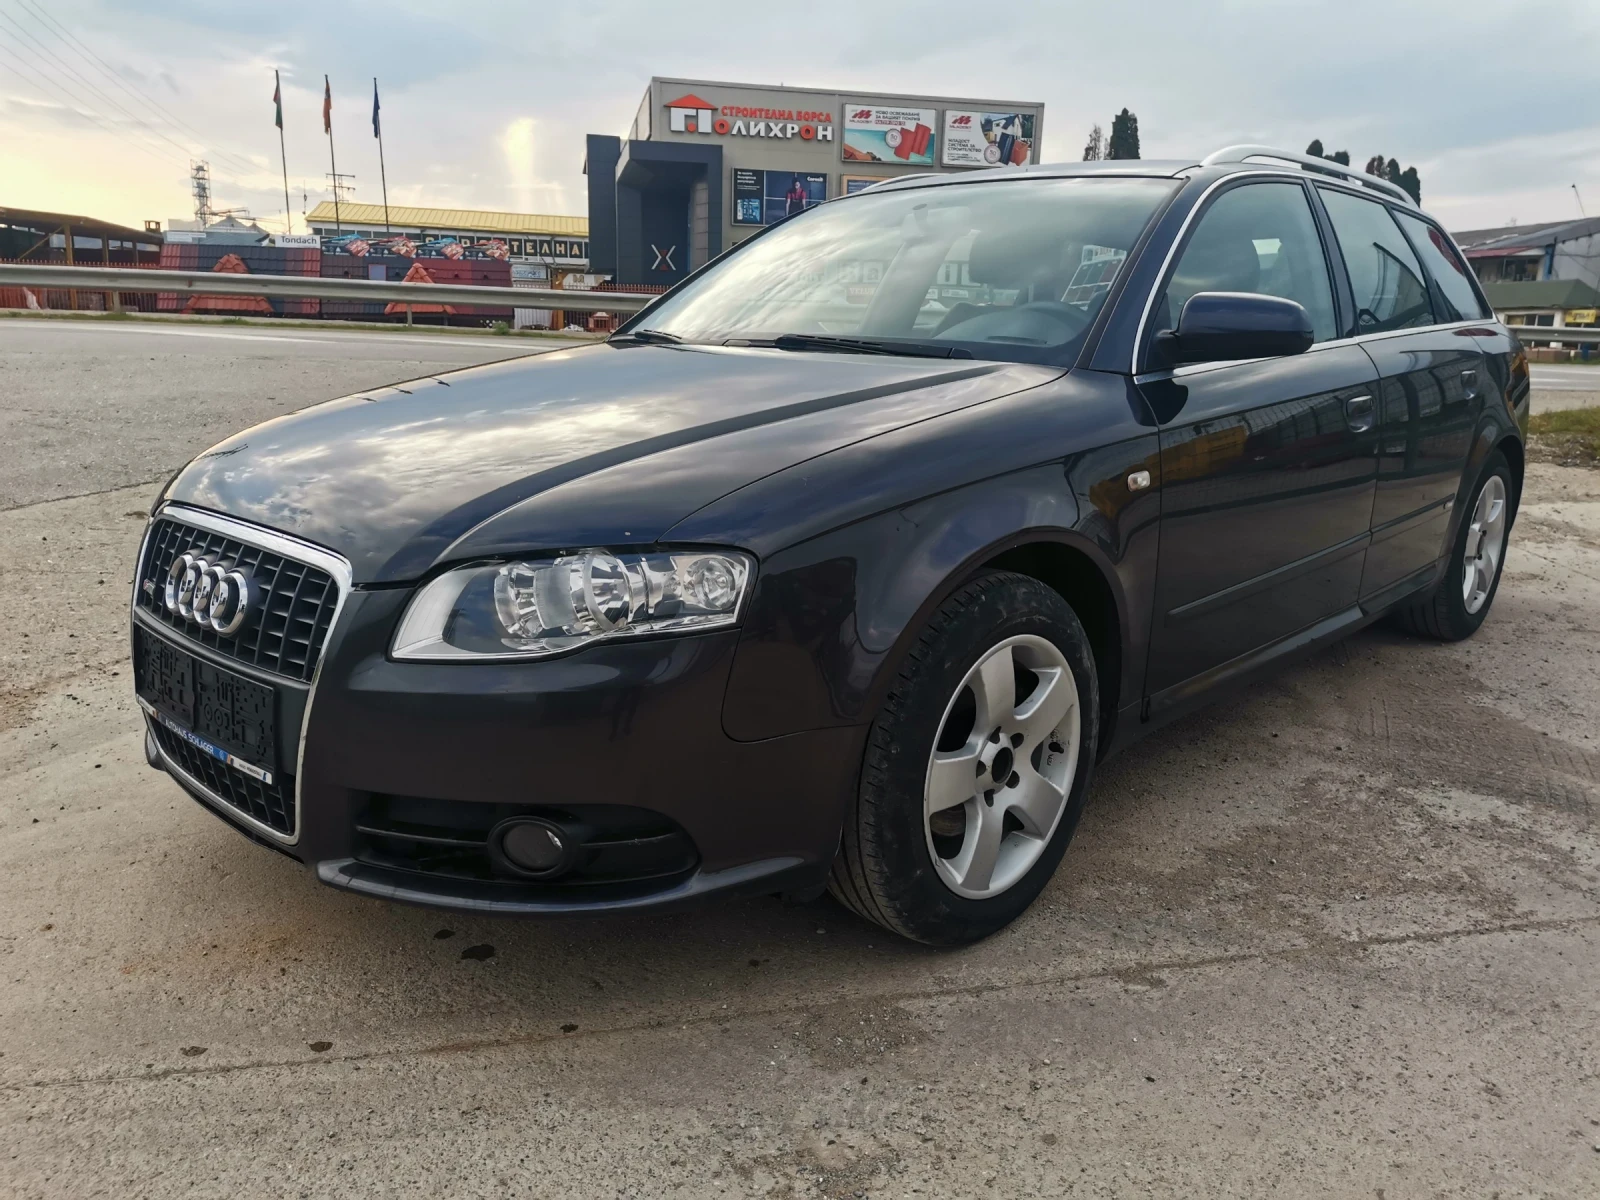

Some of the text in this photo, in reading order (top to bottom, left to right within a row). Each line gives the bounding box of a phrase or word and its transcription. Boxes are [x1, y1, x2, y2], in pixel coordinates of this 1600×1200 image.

[721, 105, 833, 123] СТРОИТЕЛНА БОРСА
[281, 235, 317, 244] Tondach
